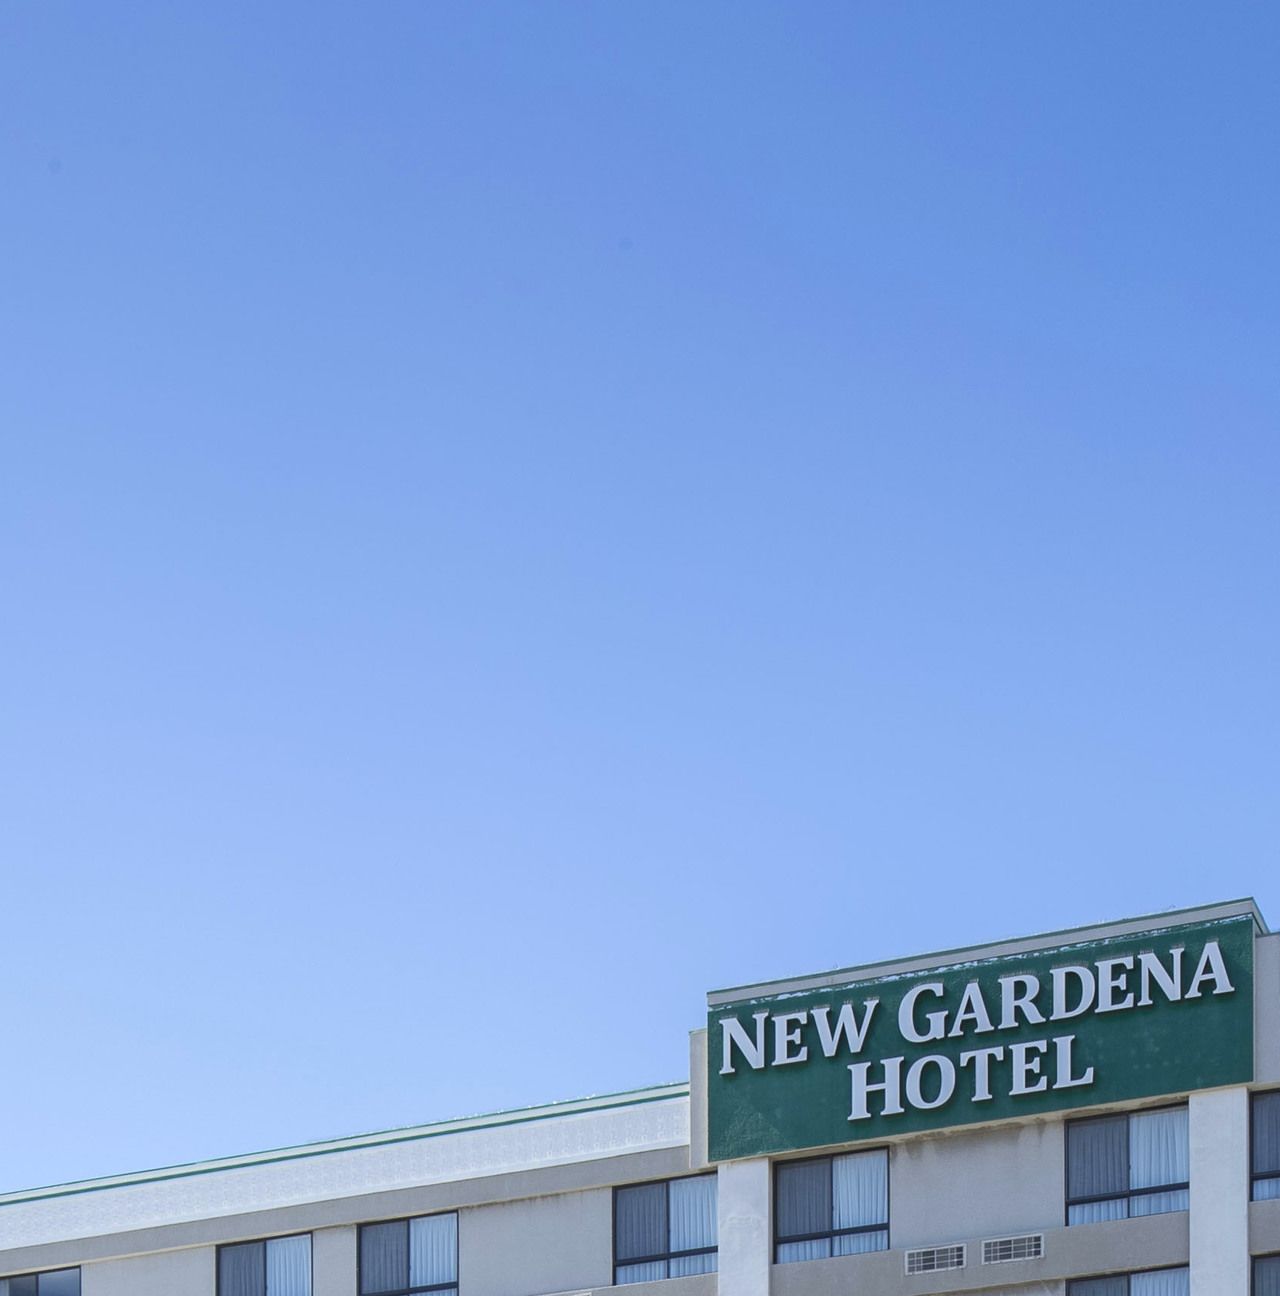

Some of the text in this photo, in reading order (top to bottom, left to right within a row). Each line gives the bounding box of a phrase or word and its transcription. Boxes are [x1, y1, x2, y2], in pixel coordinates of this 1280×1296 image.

[719, 941, 1235, 1075] NEW GARDENA
[847, 1035, 1094, 1121] HOTEL
